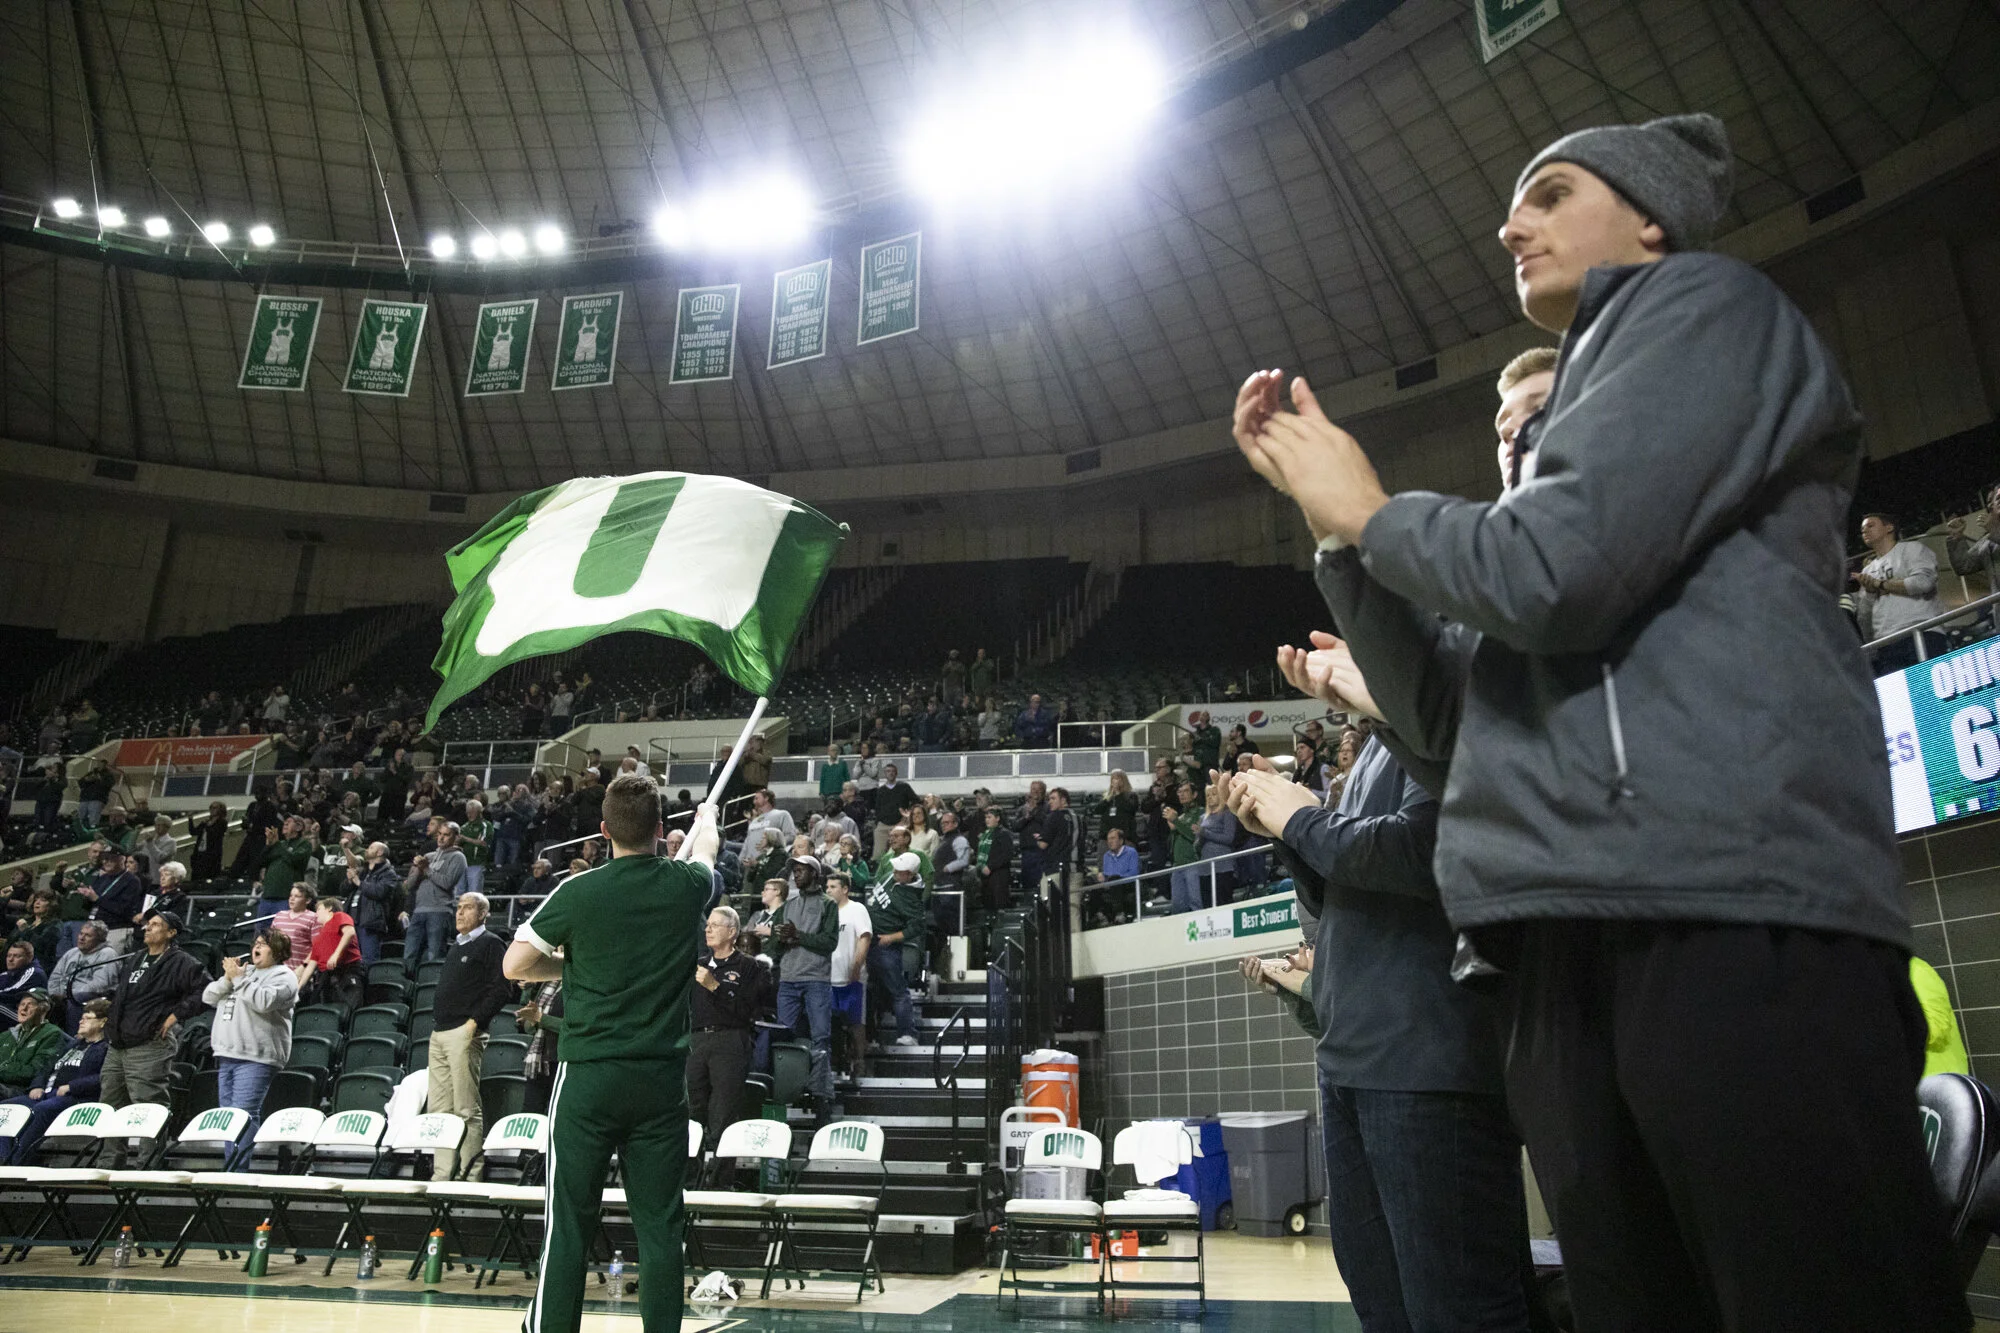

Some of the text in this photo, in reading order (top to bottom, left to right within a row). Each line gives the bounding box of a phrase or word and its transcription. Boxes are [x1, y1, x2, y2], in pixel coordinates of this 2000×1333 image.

[875, 246, 907, 272] OHIO
[787, 272, 818, 297] OHIO
[882, 277, 899, 288] MAC
[866, 280, 913, 300] TOURNAMENT
[573, 298, 612, 310] GARDNER
[868, 289, 911, 308] CHAMPIONS
[269, 302, 308, 312] BLOSSER
[691, 294, 724, 316] OHIO
[376, 306, 411, 317] HOUSKA
[491, 306, 524, 317] DANIELS
[697, 324, 714, 332] MAC
[778, 317, 820, 332] CHAMPIONS
[680, 331, 730, 340] TOURNAMENT
[682, 339, 726, 349] CHAMPIONS
[562, 362, 606, 370] NATIONAL
[248, 370, 300, 378] CHAMPION
[356, 369, 402, 378] NATIONAL
[476, 369, 519, 378] NATIONAL
[560, 368, 608, 377] CHAMPION
[352, 374, 404, 384] CHAMPION
[473, 374, 520, 384] CHAMPION
[1212, 712, 1306, 724] pepsi pepsi
[1949, 697, 2000, 784] 6
[1260, 908, 1288, 926] STUDENT
[66, 1106, 102, 1127] OHIO
[198, 1110, 234, 1132] OHIO
[335, 1113, 372, 1136] OHIO
[503, 1117, 540, 1140] OHIO
[828, 1126, 868, 1152] OHIO
[1044, 1132, 1086, 1160] OHIO
[256, 1238, 268, 1250] G
[428, 1243, 438, 1256] G
[1110, 1242, 1123, 1256] G
